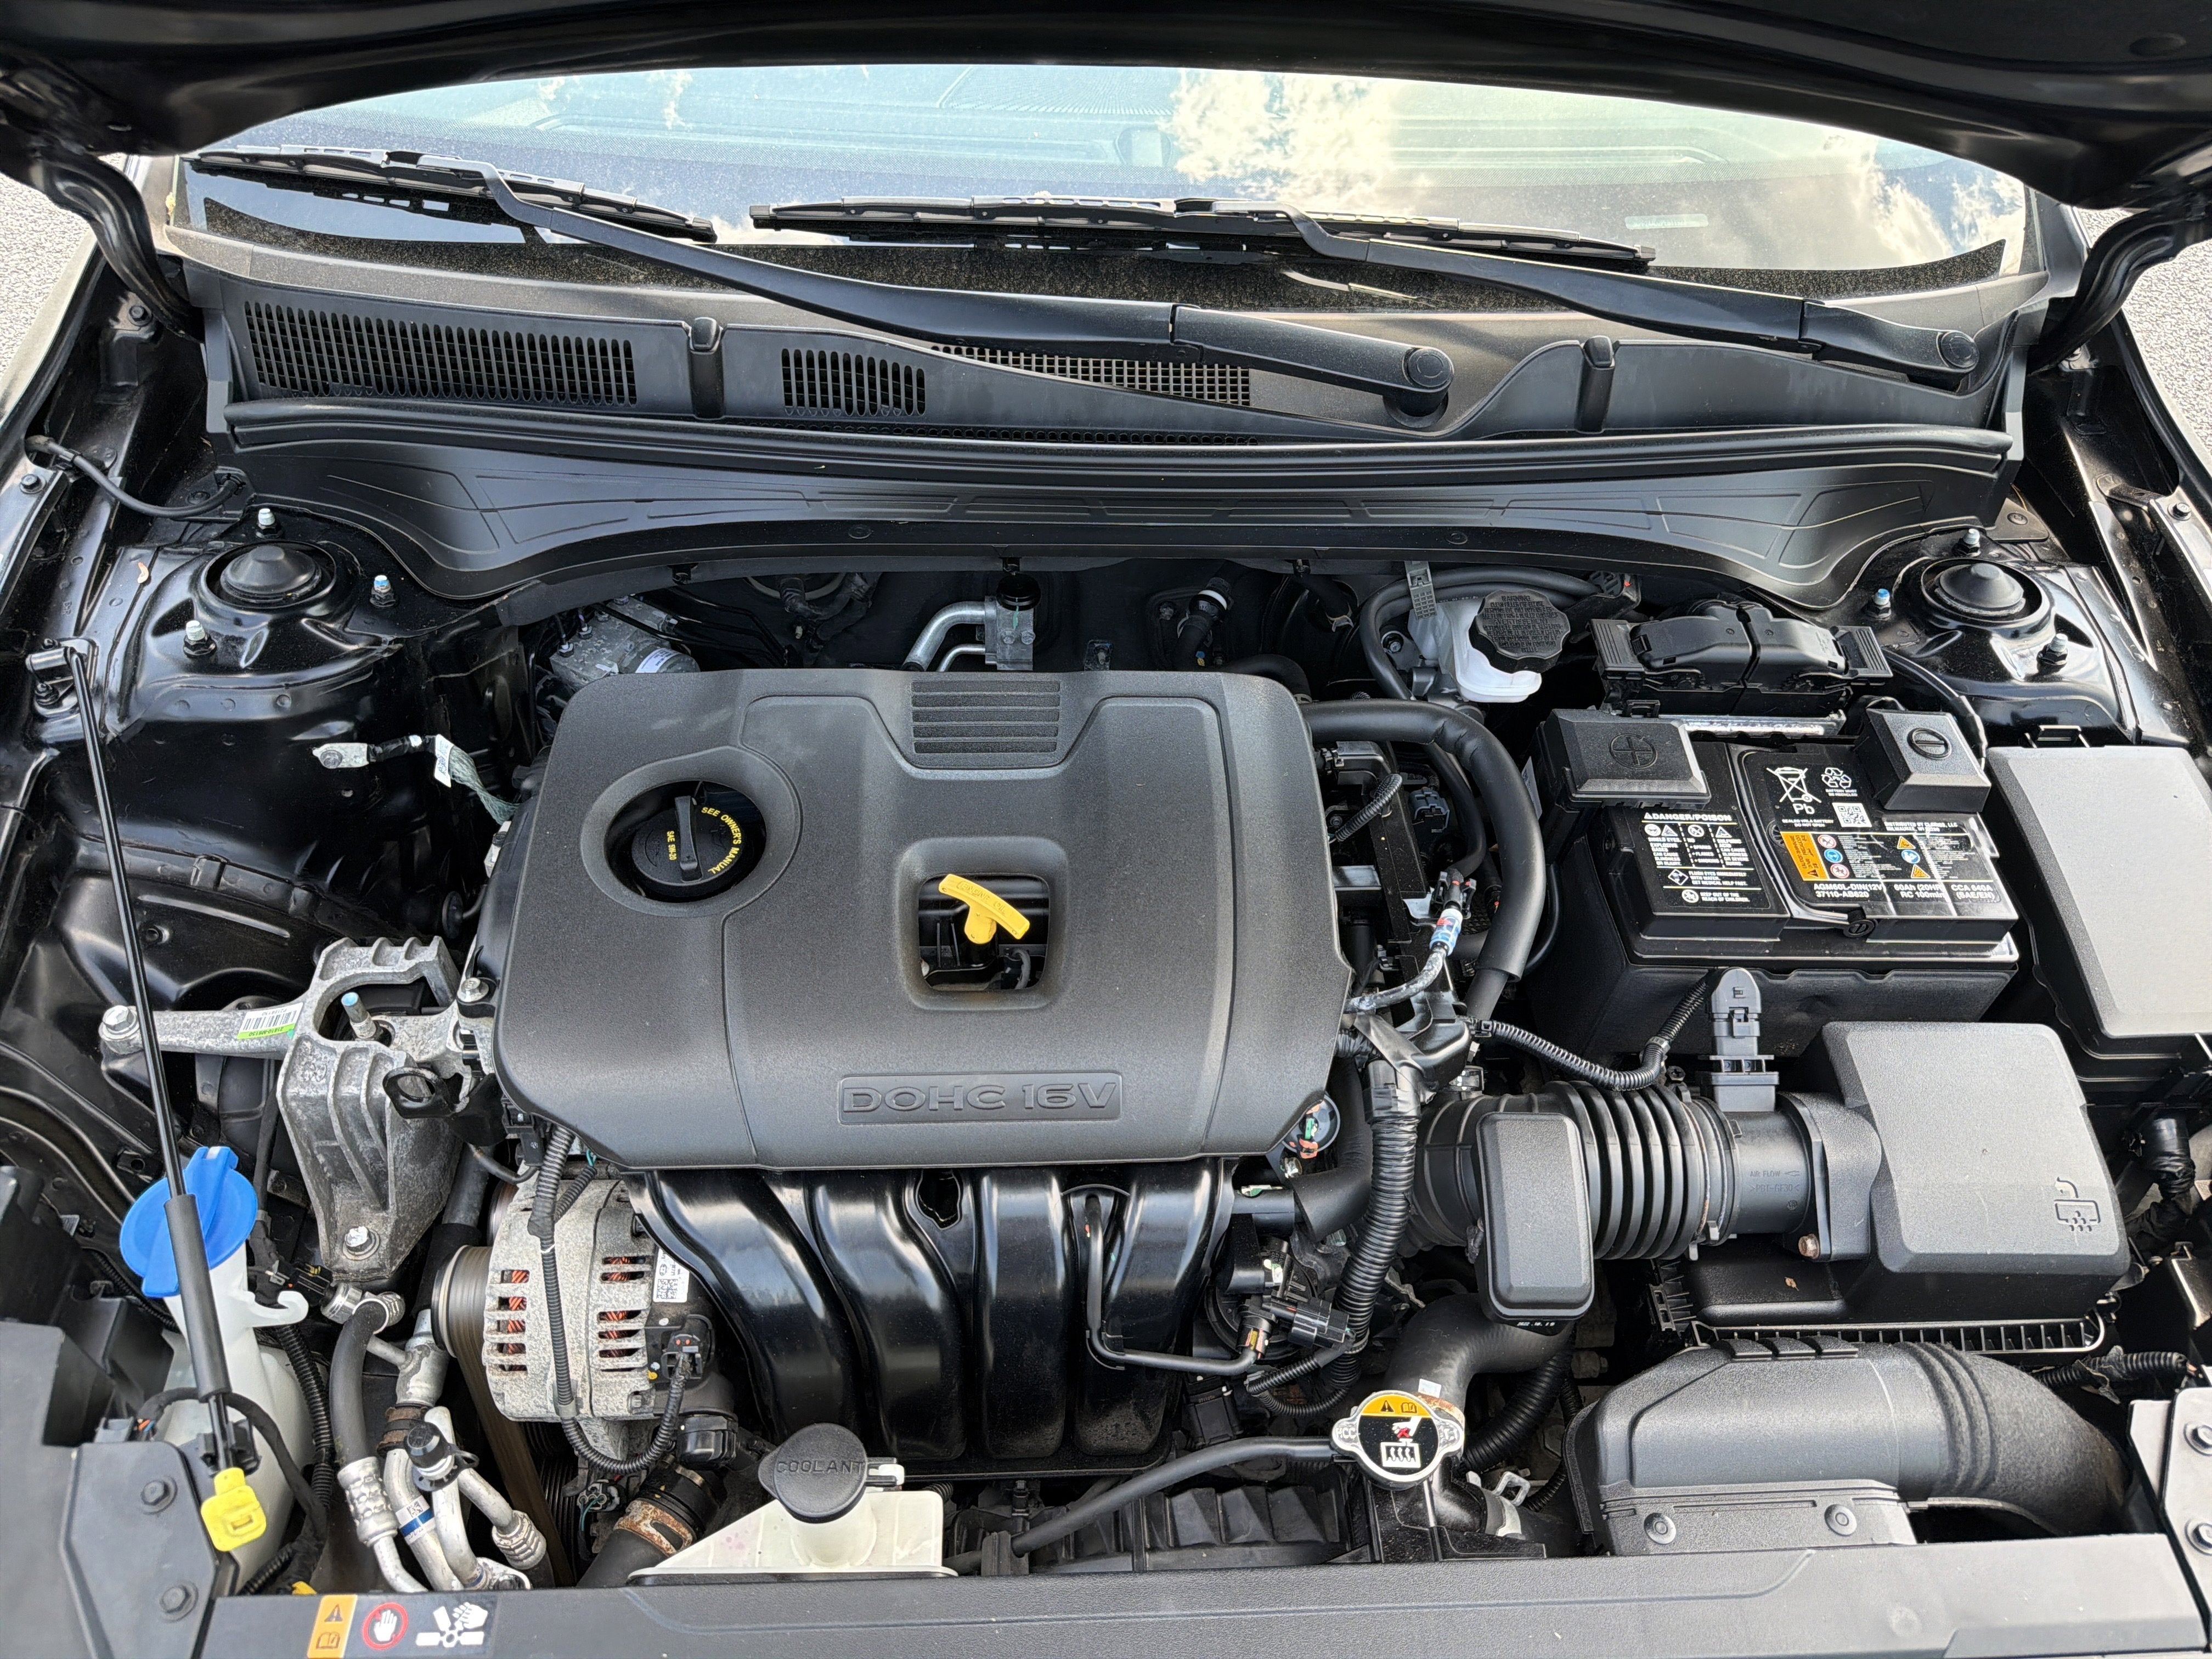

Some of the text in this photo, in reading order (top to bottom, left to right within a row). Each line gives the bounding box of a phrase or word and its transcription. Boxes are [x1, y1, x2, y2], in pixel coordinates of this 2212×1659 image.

[1652, 813, 1732, 821] DANGER/POISON
[1793, 803, 1815, 814] Pb
[701, 806, 742, 874] SEE OWNER'S MANUAL
[668, 844, 677, 861] 5W-20
[961, 882, 1005, 914] ENGINE OIL
[843, 1082, 1117, 1114] DOHC 16V
[777, 1460, 865, 1474] COOLANT
